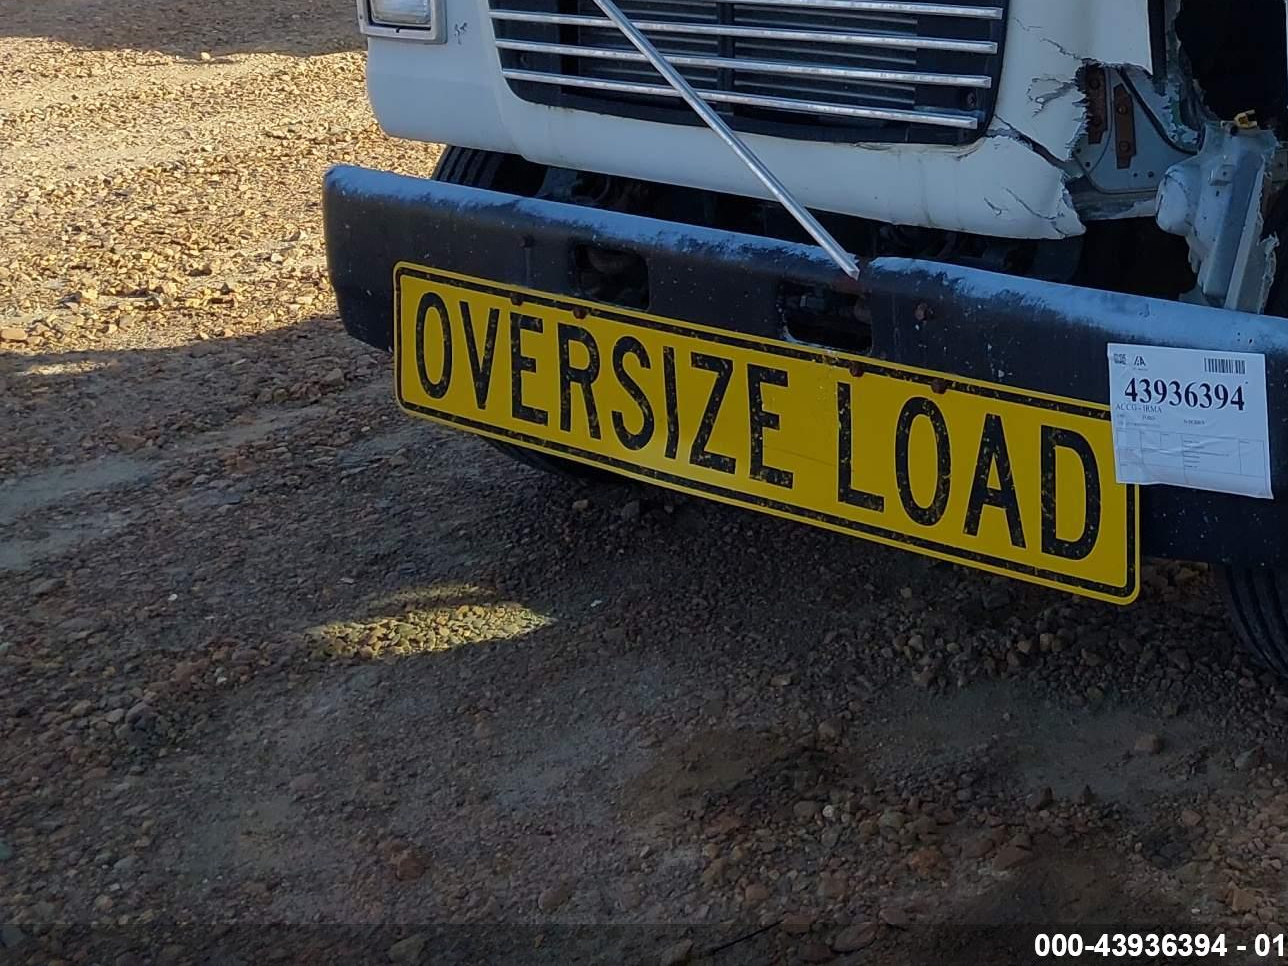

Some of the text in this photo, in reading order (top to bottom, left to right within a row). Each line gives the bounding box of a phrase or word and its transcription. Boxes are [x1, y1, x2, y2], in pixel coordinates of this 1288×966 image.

[416, 292, 1101, 561] OVERSIZE LOAD
[1124, 377, 1245, 411] 43936394
